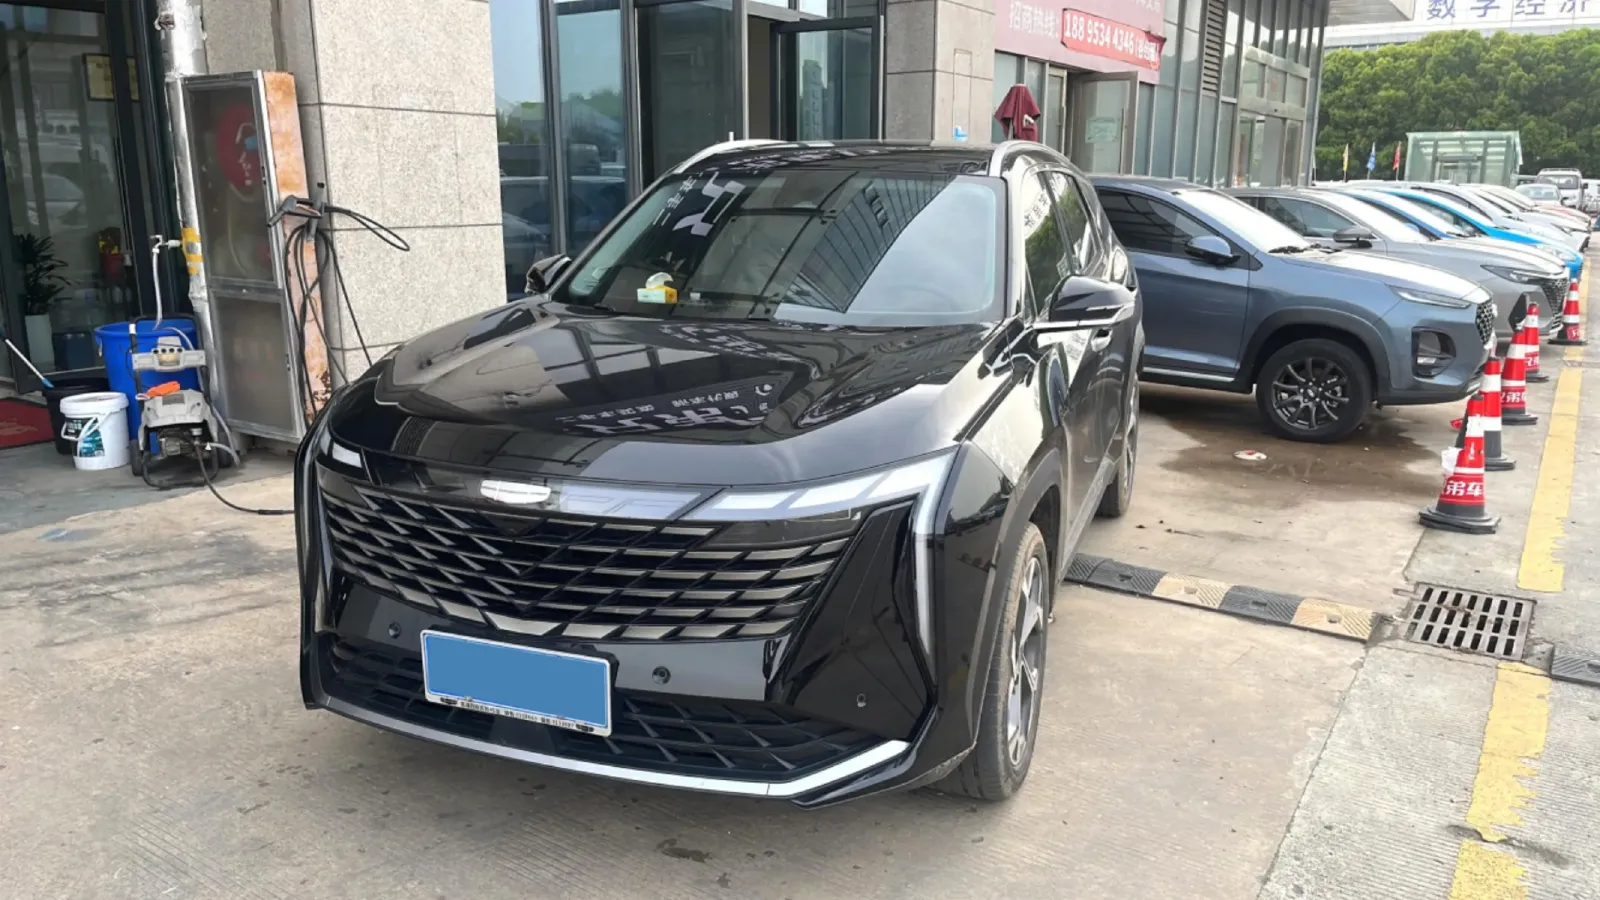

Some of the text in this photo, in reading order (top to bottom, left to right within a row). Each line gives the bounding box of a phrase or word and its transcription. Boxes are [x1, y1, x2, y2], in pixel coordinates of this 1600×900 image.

[1065, 13, 1085, 42] 188
[1087, 22, 1111, 49] 9534
[1112, 27, 1134, 56] 4346
